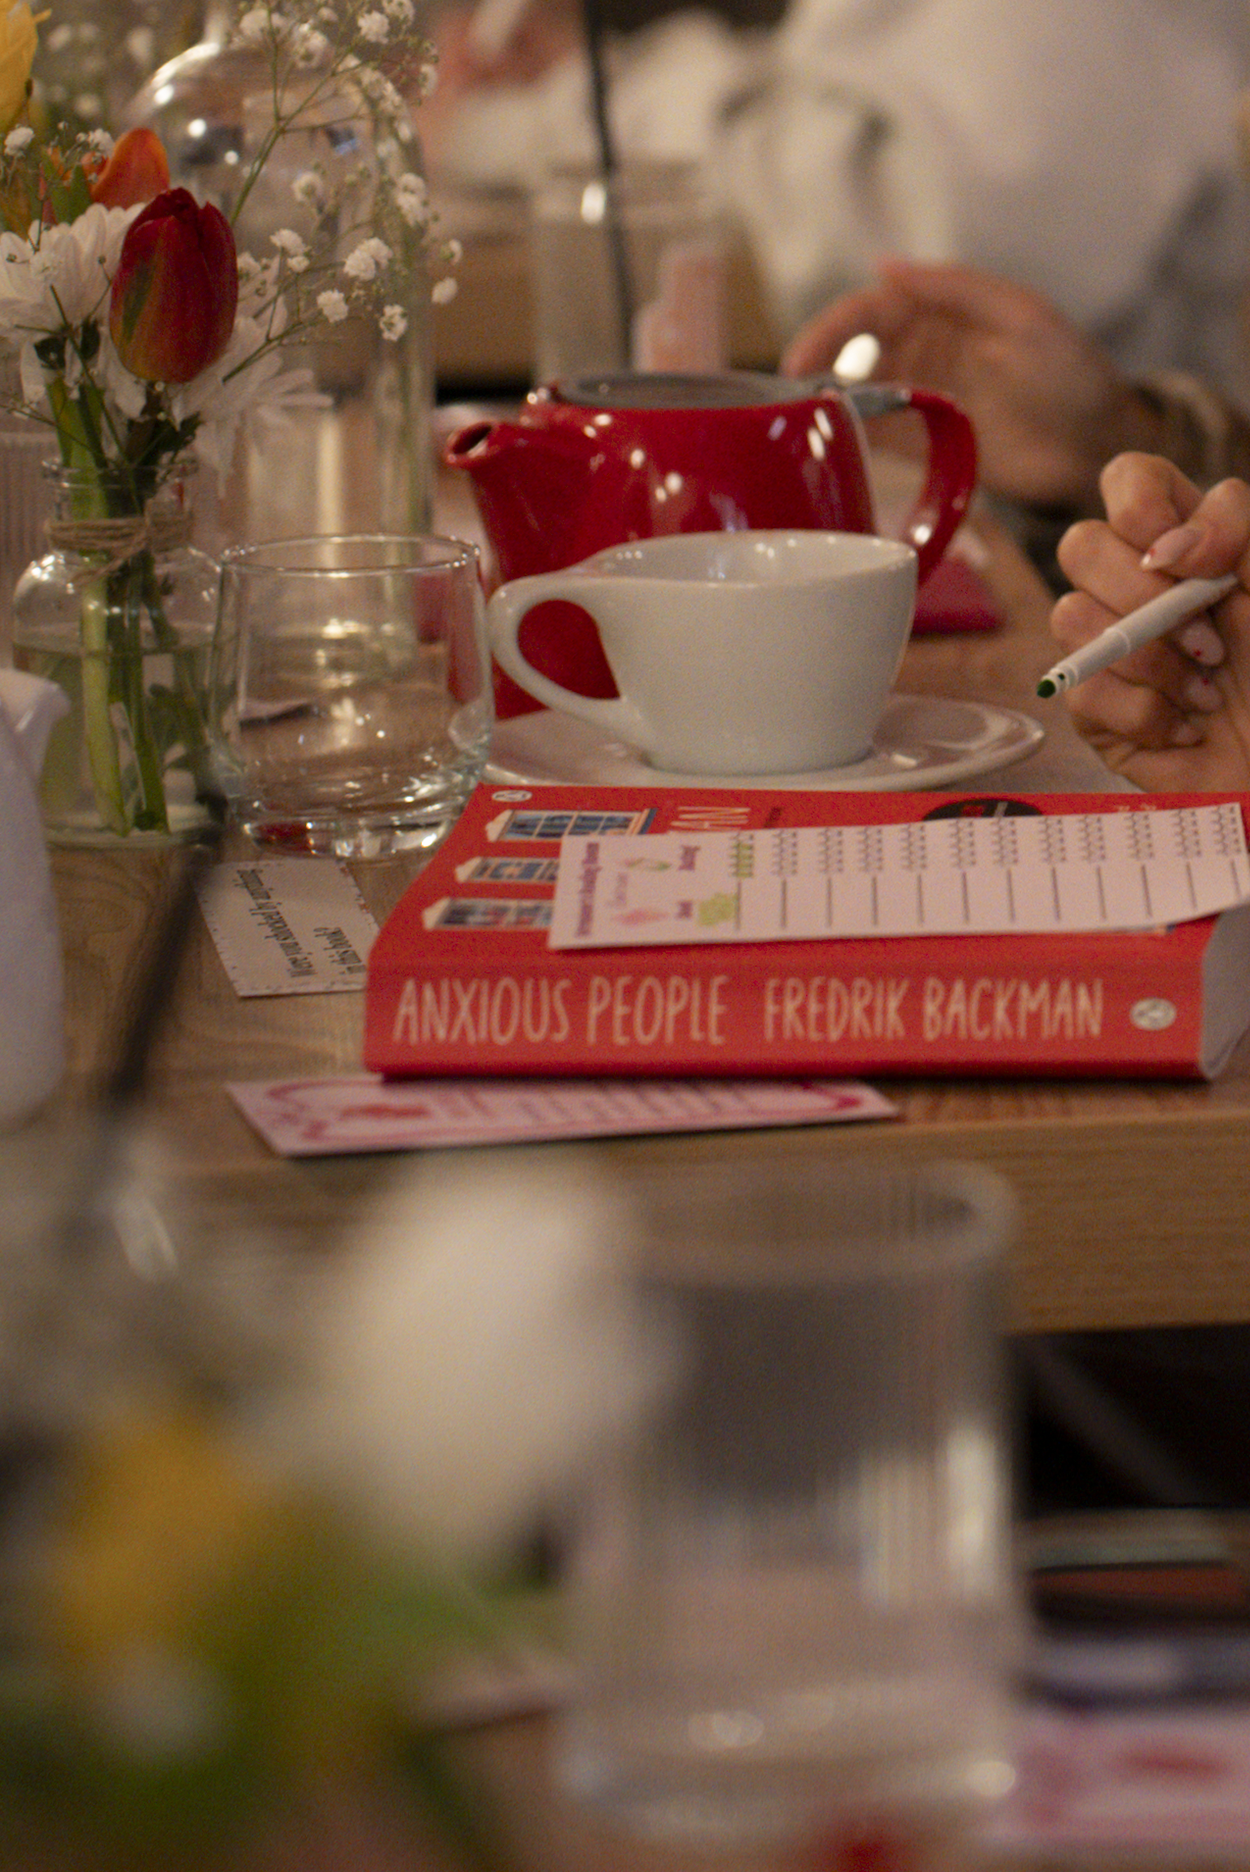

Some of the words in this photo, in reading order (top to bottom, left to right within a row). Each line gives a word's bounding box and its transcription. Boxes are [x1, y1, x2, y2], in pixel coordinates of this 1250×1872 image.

[392, 976, 573, 1046] ANXIOUS
[586, 974, 729, 1046] PEOPLE
[764, 975, 910, 1043] FREDRIK
[922, 976, 1103, 1043] BACKMAN
